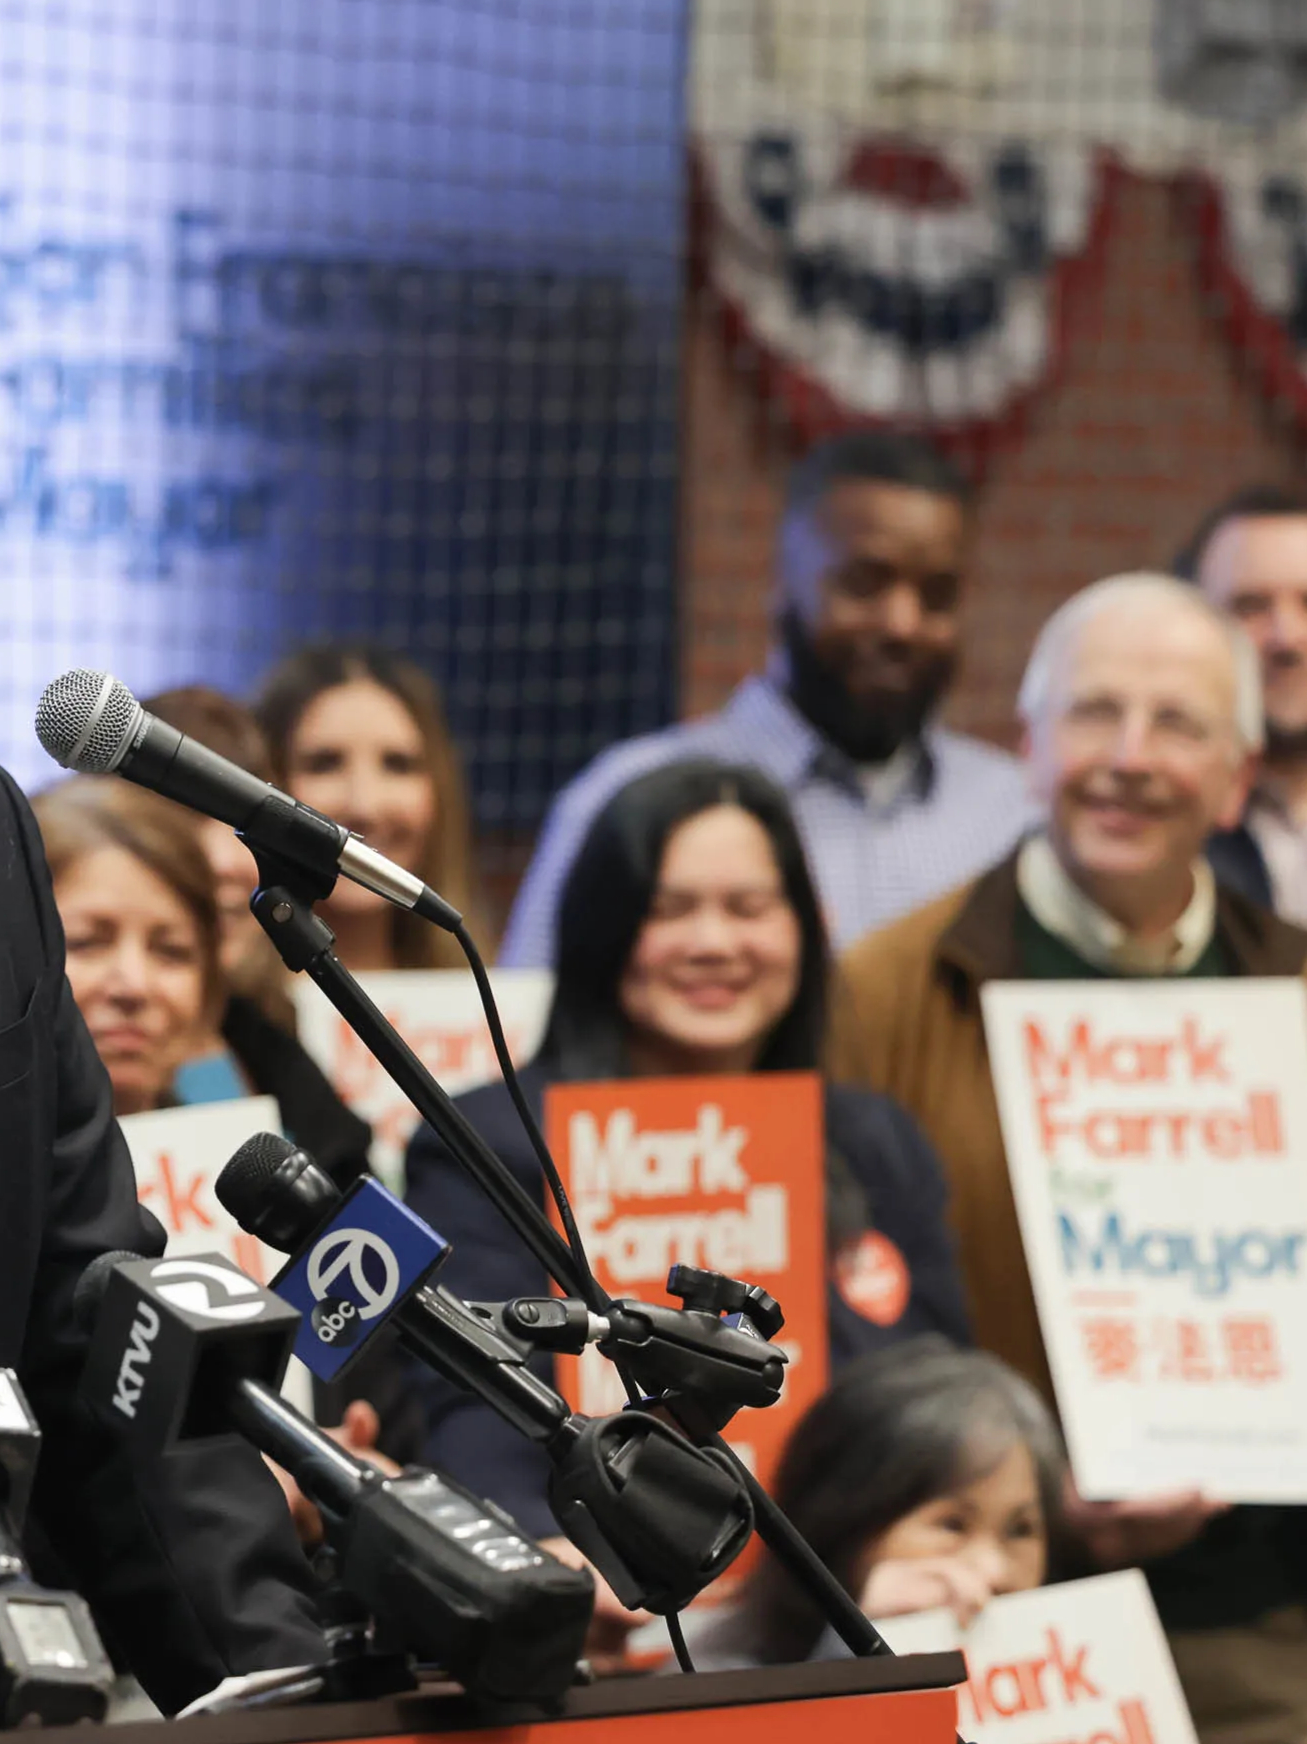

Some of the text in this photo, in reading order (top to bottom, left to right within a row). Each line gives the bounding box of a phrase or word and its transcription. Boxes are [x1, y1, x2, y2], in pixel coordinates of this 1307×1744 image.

[1023, 1014, 1232, 1092] Mark
[569, 1104, 749, 1200] Mark
[1035, 1091, 1288, 1160] Farrell
[574, 1184, 789, 1284] Farrell
[1056, 1211, 1305, 1298] Mayor
[112, 1300, 161, 1419] KTVU
[318, 1301, 356, 1342] abc
